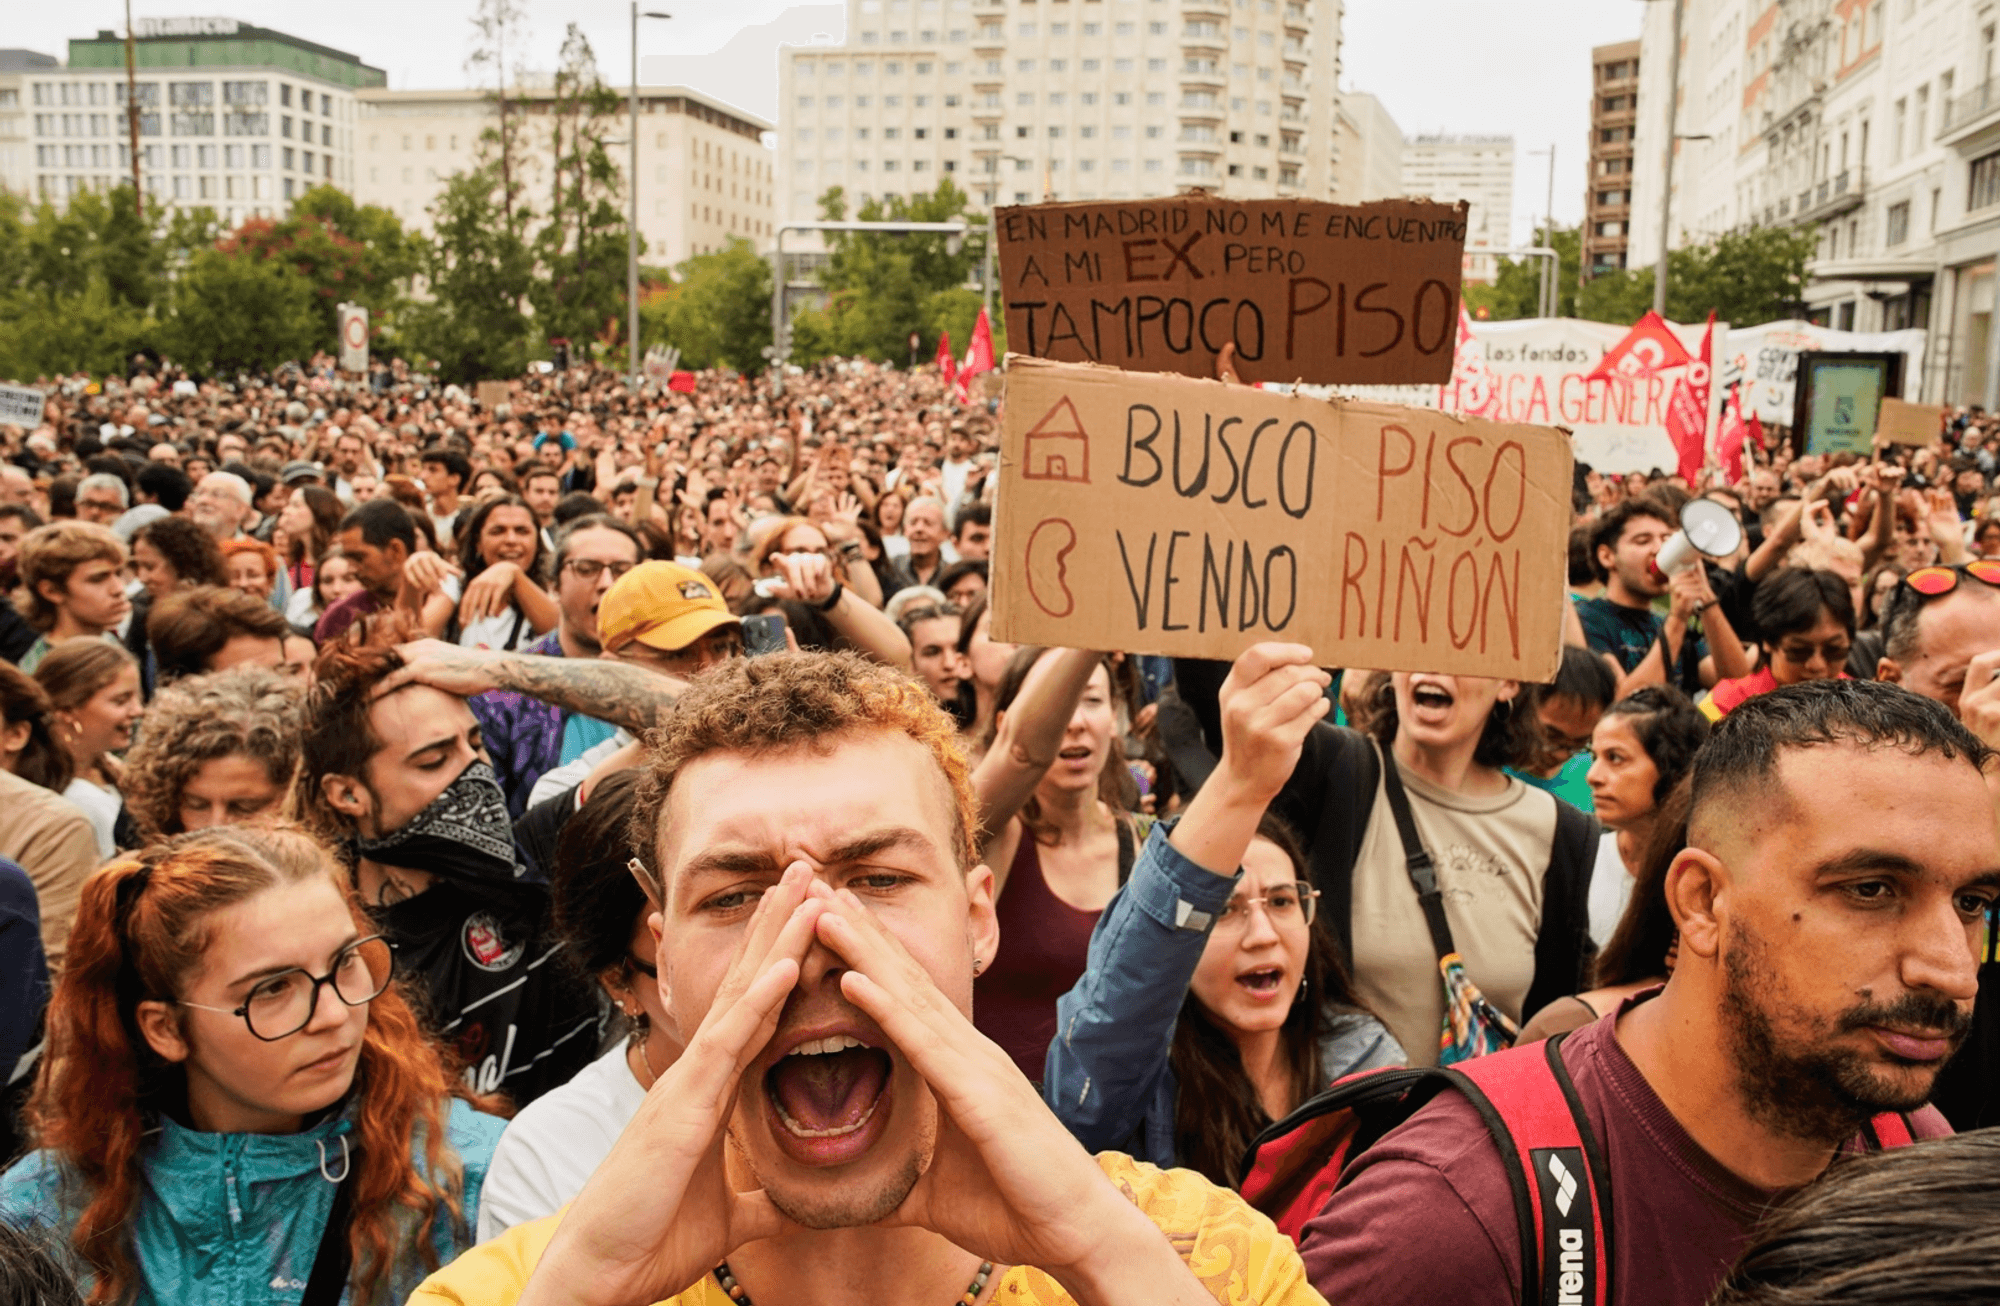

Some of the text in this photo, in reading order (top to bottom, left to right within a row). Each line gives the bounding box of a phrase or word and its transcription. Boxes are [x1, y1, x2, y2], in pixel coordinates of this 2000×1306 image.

[1006, 214, 1047, 242] EN
[1065, 208, 1189, 240] MADRID
[1206, 208, 1248, 236] NO
[1262, 211, 1310, 239] ME
[1019, 254, 1050, 288] A
[1065, 249, 1101, 283] MI
[1224, 242, 1306, 275] PERO
[1009, 277, 1451, 362] TAMPOCO PISO
[1558, 372, 1666, 426] GENER
[1117, 404, 1526, 542] BUSCO PISO
[1116, 530, 1521, 660] VENDO RIÑÓN
[1558, 1229, 1584, 1306] rena
